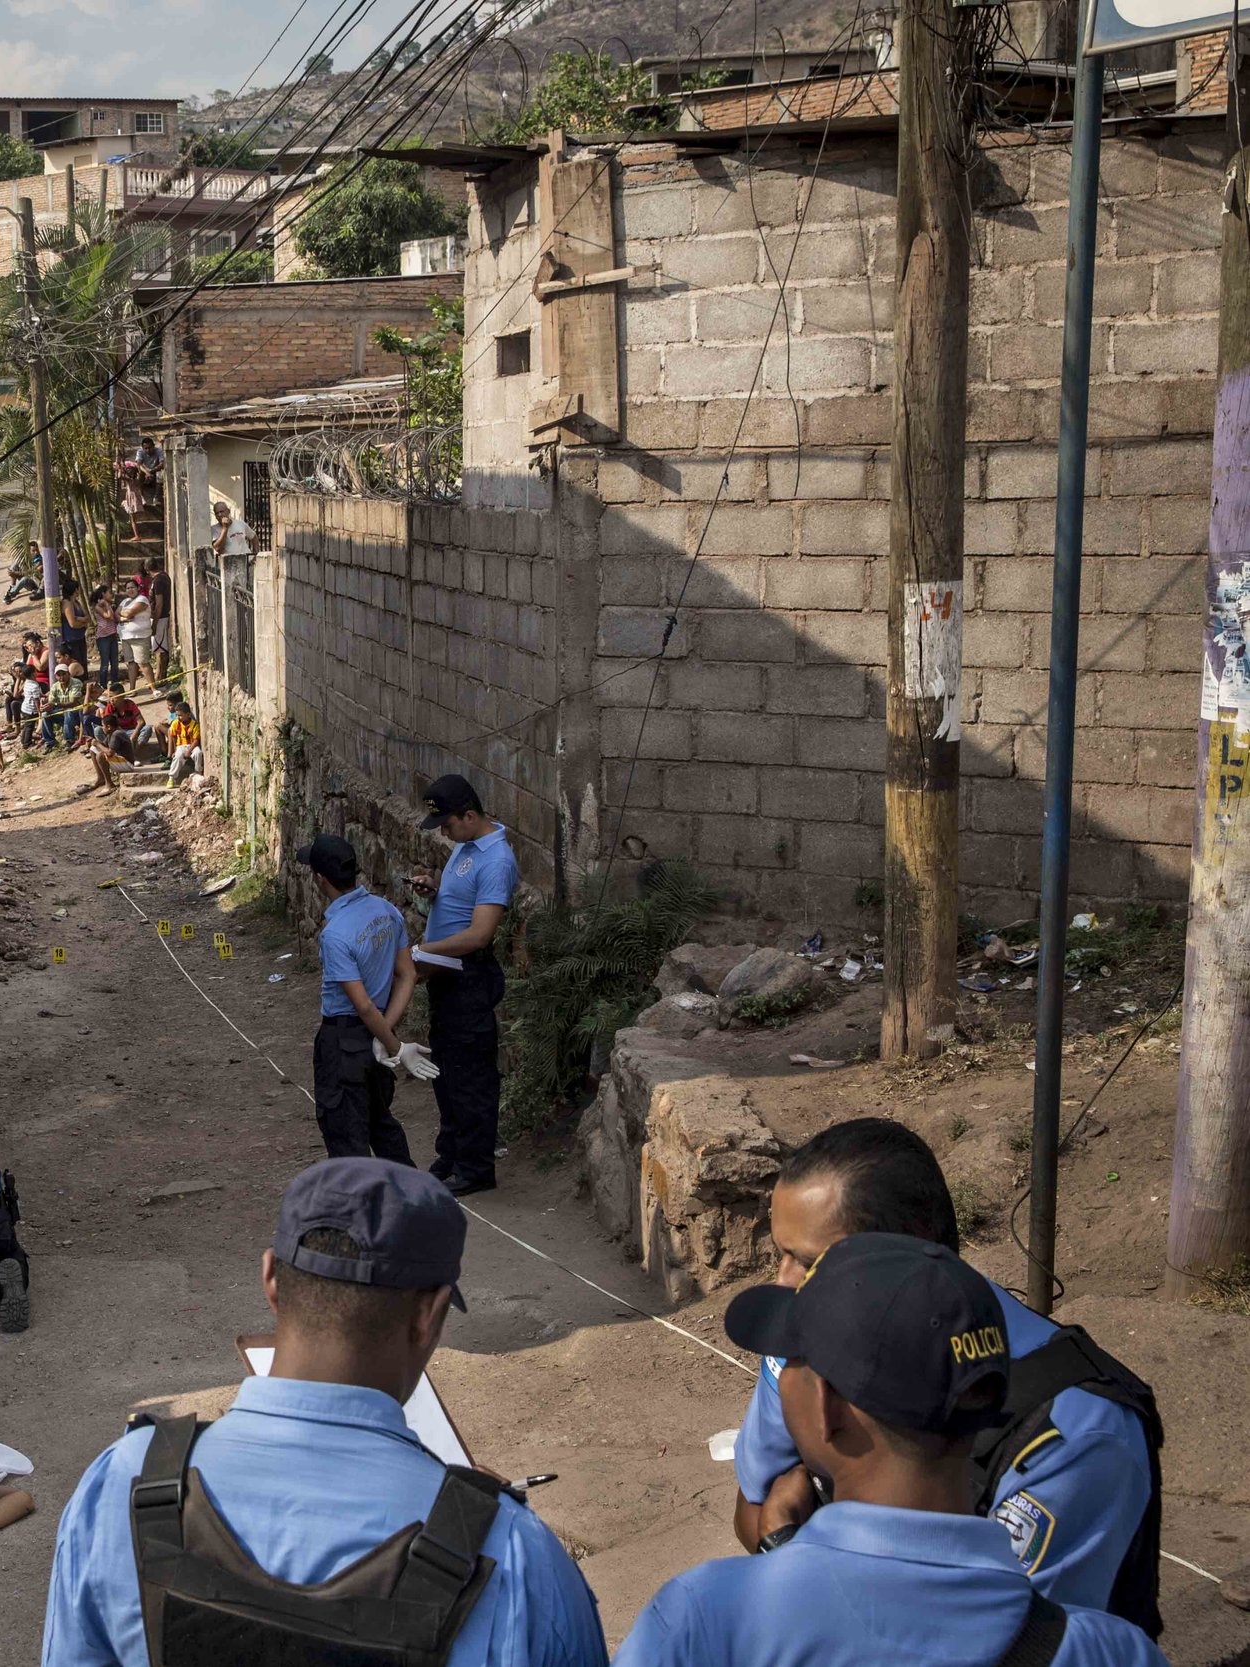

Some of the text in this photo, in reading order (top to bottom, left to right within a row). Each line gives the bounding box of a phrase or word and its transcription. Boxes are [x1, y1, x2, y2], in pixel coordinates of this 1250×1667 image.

[161, 922, 168, 930] 21
[216, 934, 223, 943] 19
[55, 948, 63, 957] 18
[222, 945, 230, 954] 17
[1007, 1494, 1042, 1520] URAS
